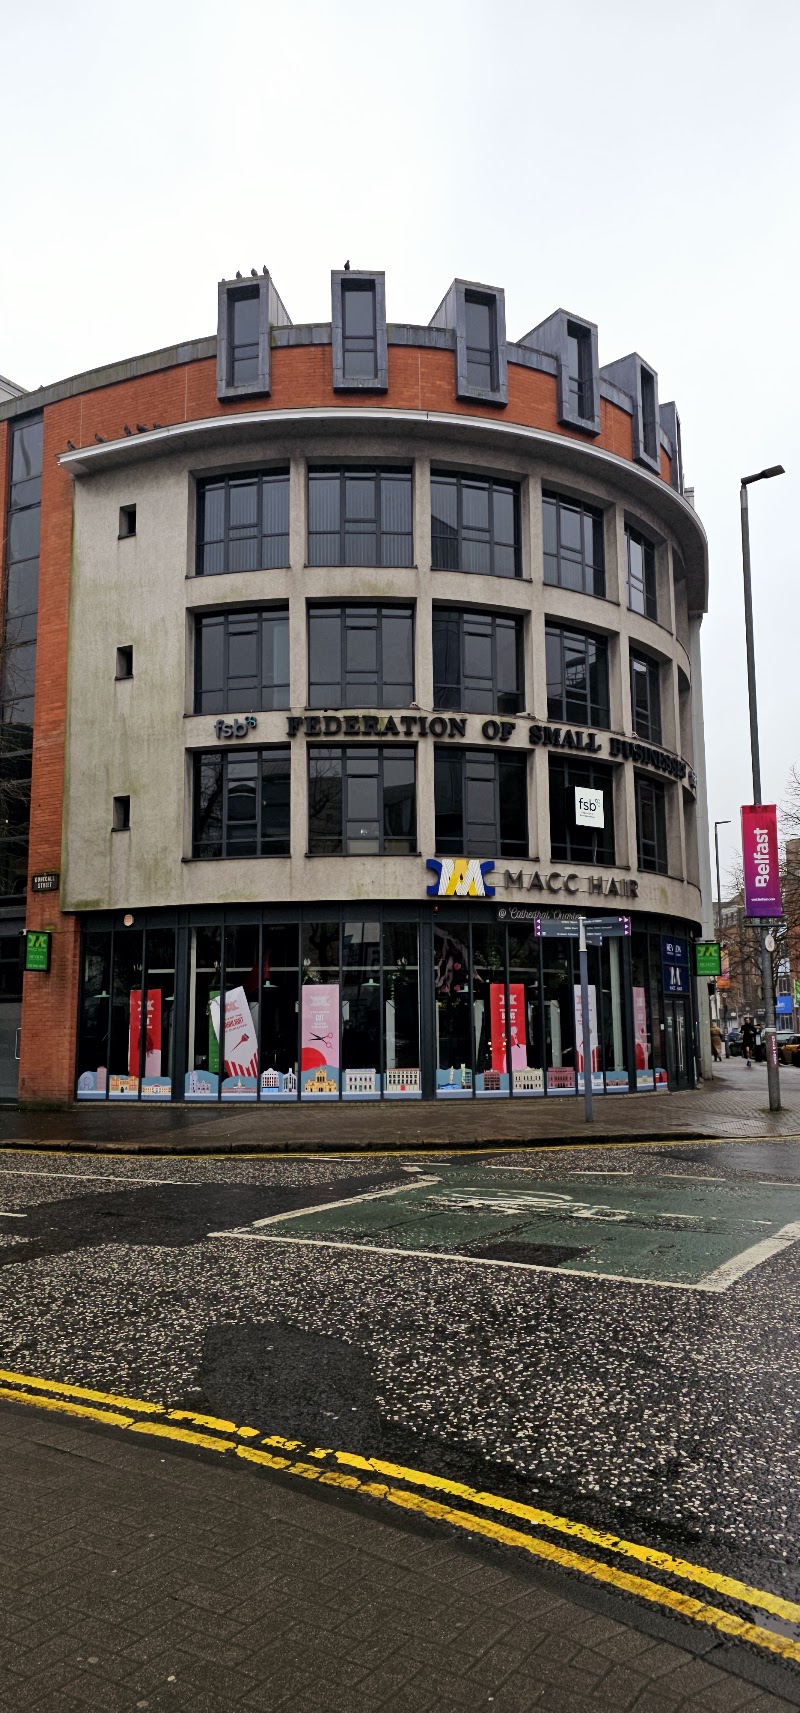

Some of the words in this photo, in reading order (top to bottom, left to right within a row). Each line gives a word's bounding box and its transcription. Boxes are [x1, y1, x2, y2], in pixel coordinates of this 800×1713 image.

[214, 719, 248, 739] fsb
[286, 715, 467, 738] FEDERATION
[482, 719, 516, 741] OF
[529, 724, 602, 752] SMALL
[609, 737, 687, 779] BUSINESSES
[578, 797, 597, 812] fsb
[753, 827, 770, 888] Belfast
[504, 869, 579, 893] MACC
[588, 875, 639, 898] HAIR
